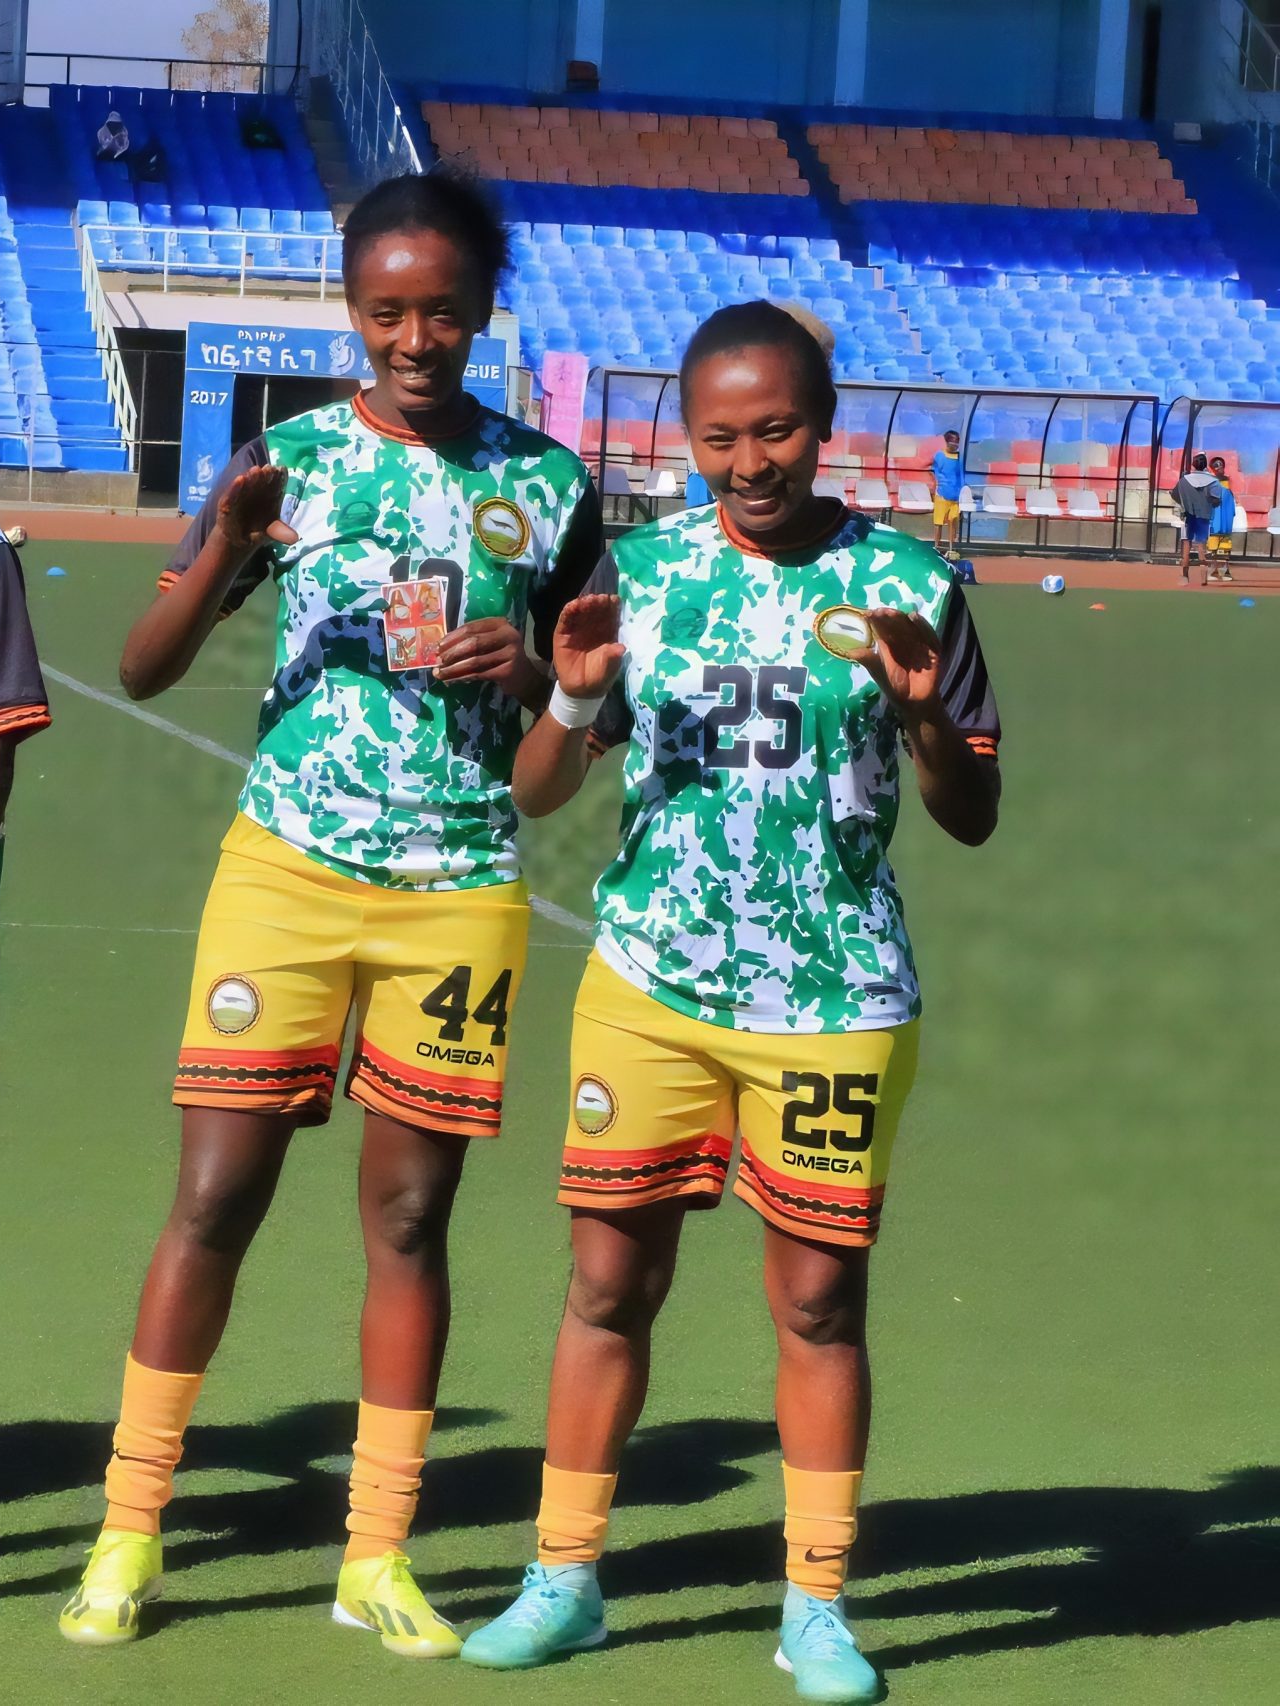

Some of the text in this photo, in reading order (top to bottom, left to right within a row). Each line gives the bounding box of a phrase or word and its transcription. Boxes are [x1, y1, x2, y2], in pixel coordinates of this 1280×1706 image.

[190, 390, 229, 407] 2017
[702, 664, 808, 769] 25
[419, 965, 512, 1046] 44
[416, 1041, 495, 1067] OMEGA
[782, 1070, 879, 1152] 25
[782, 1149, 864, 1174] OMEGA
